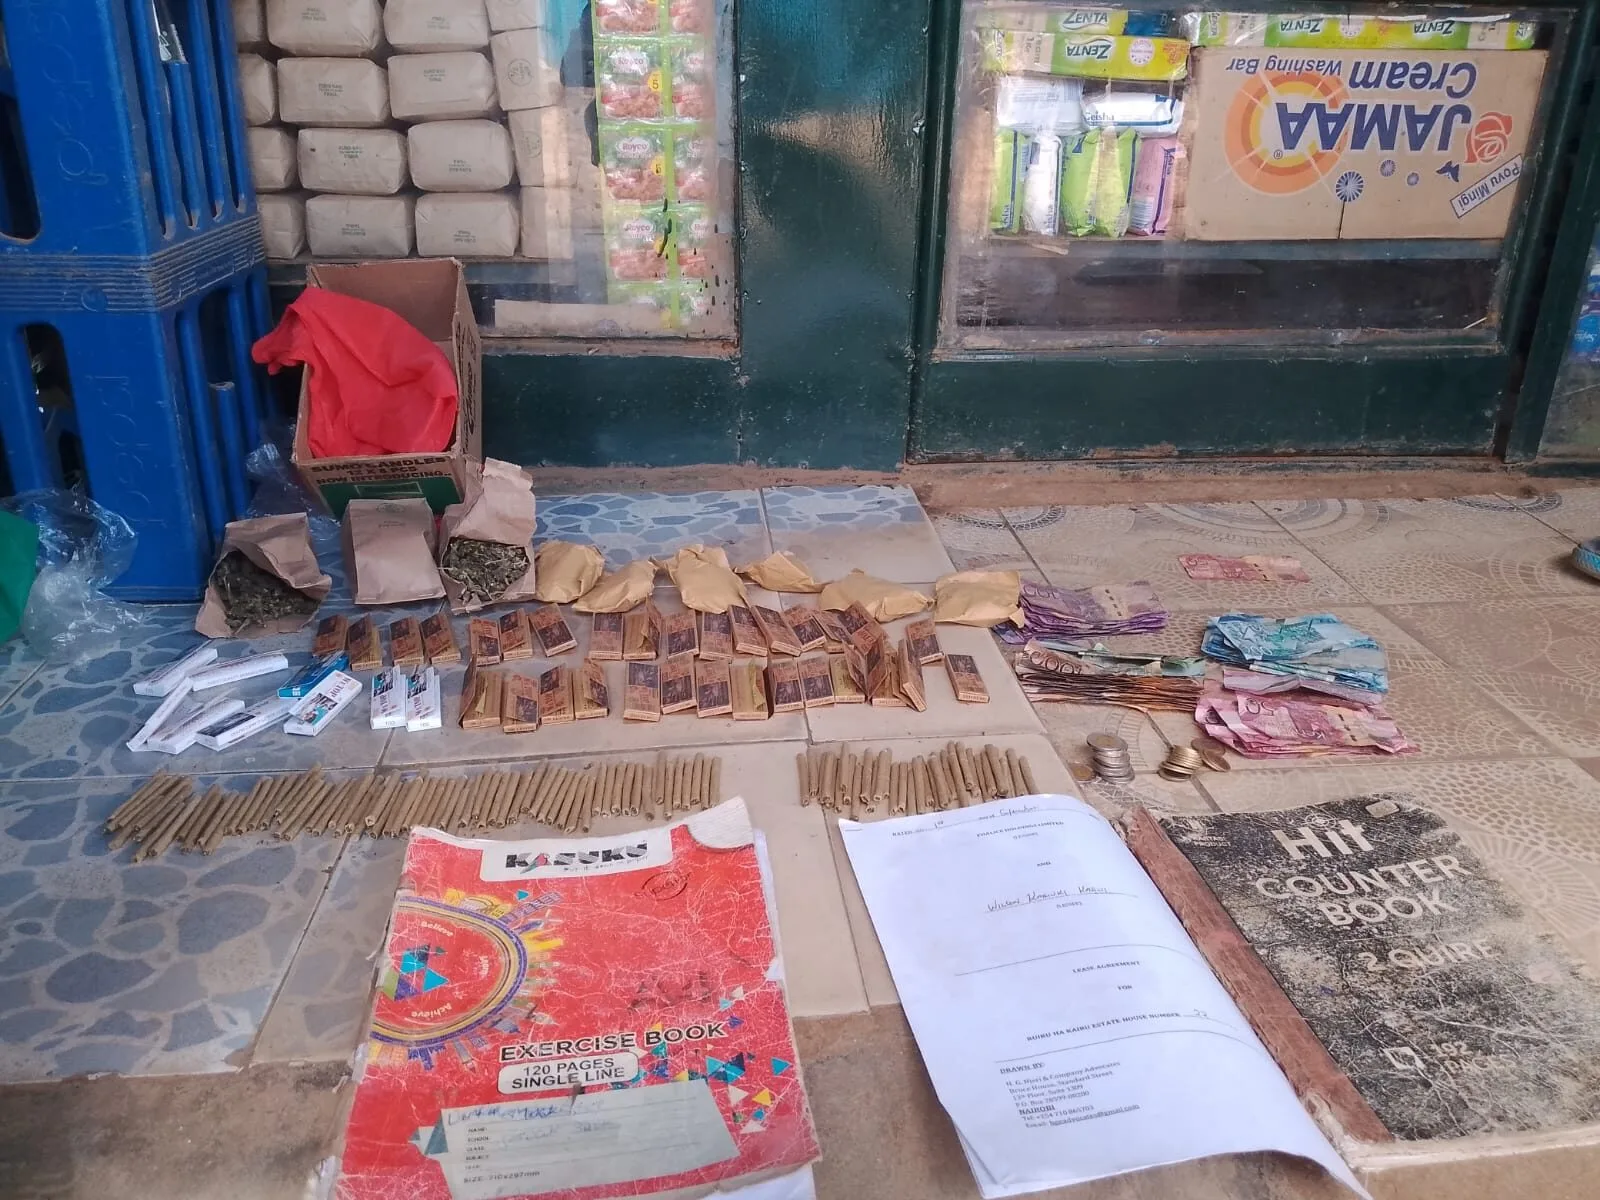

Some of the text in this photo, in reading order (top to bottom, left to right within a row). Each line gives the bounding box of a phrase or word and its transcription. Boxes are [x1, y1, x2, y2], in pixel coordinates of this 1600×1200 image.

[1064, 11, 1108, 25] ZENTA
[1280, 19, 1323, 34] ZENTA
[1413, 19, 1454, 35] ZENTA
[1066, 43, 1112, 60] ZENTA
[652, 79, 659, 90] 5
[1226, 55, 1477, 99] Cream Washing Bar
[1275, 102, 1472, 152] JAMAA
[622, 142, 648, 151] Royco
[1457, 162, 1522, 212] Povu Mingi
[1271, 818, 1375, 861] Hit
[506, 843, 648, 874] KASUKU
[1255, 854, 1473, 900] COUNTER
[1317, 888, 1462, 927] BOOK
[1356, 938, 1500, 972] 2 QUIRE
[1096, 960, 1140, 970] AGREEMENT
[411, 1003, 453, 1018] Achieve
[1092, 1018, 1120, 1028] ESTATE
[1122, 1014, 1147, 1023] HOUSE
[1148, 1011, 1181, 1019] NUMBER
[501, 1022, 727, 1061] EXERCISE BOOK
[523, 1058, 615, 1077] 120 PAGES
[1000, 1064, 1031, 1074] DRAWN
[1050, 1069, 1083, 1080] Company
[1084, 1061, 1121, 1073] Advocates
[512, 1067, 625, 1090] SINGLE LINE
[1058, 1074, 1090, 1085] Standard
[1091, 1069, 1113, 1079] Street
[1018, 1104, 1056, 1115] NAIROBI
